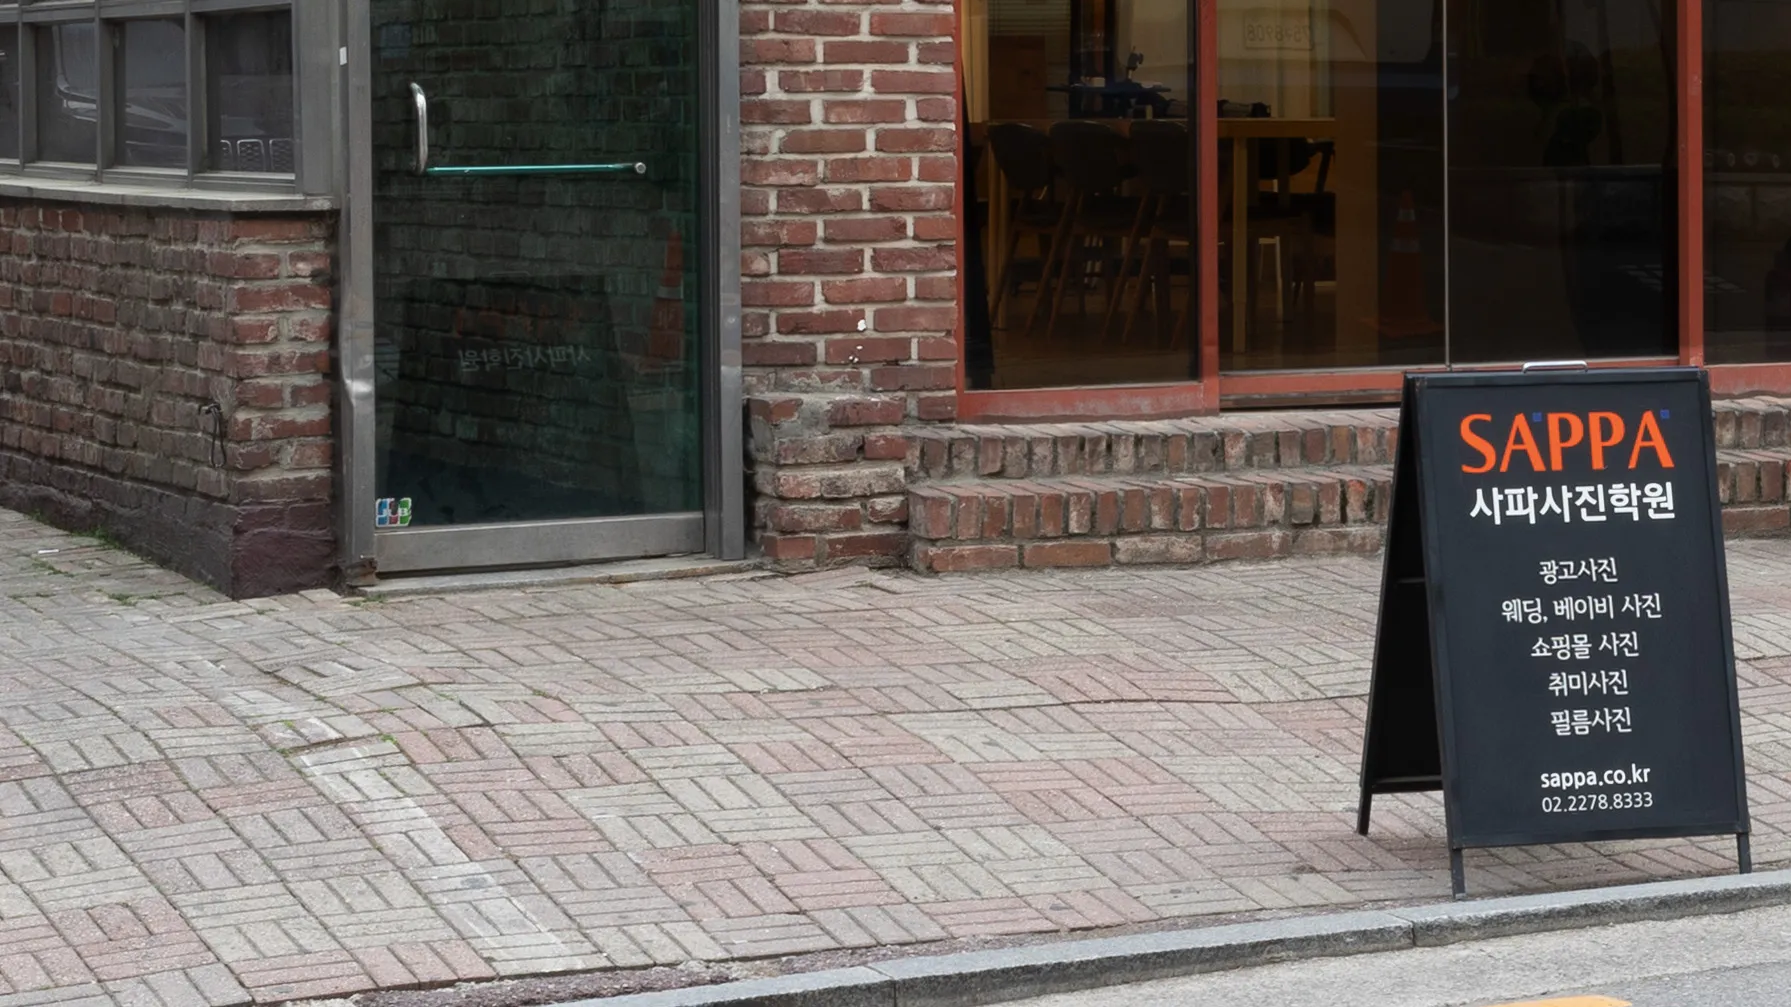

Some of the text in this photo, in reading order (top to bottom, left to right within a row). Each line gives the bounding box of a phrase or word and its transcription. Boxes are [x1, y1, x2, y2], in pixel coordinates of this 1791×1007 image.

[1460, 410, 1675, 474] SAPPA
[1469, 481, 1676, 526] 사파사진학원
[1539, 556, 1619, 585] 광고사진
[1501, 592, 1662, 625] 웨딩, 베이비 사진
[1530, 630, 1640, 661] 쇼핑몰 사진
[1548, 668, 1629, 697] 취미사진
[1550, 706, 1633, 737] 필름사진
[1540, 762, 1651, 791] sappa.co.kr
[1541, 791, 1653, 813] 02.2278.8333
